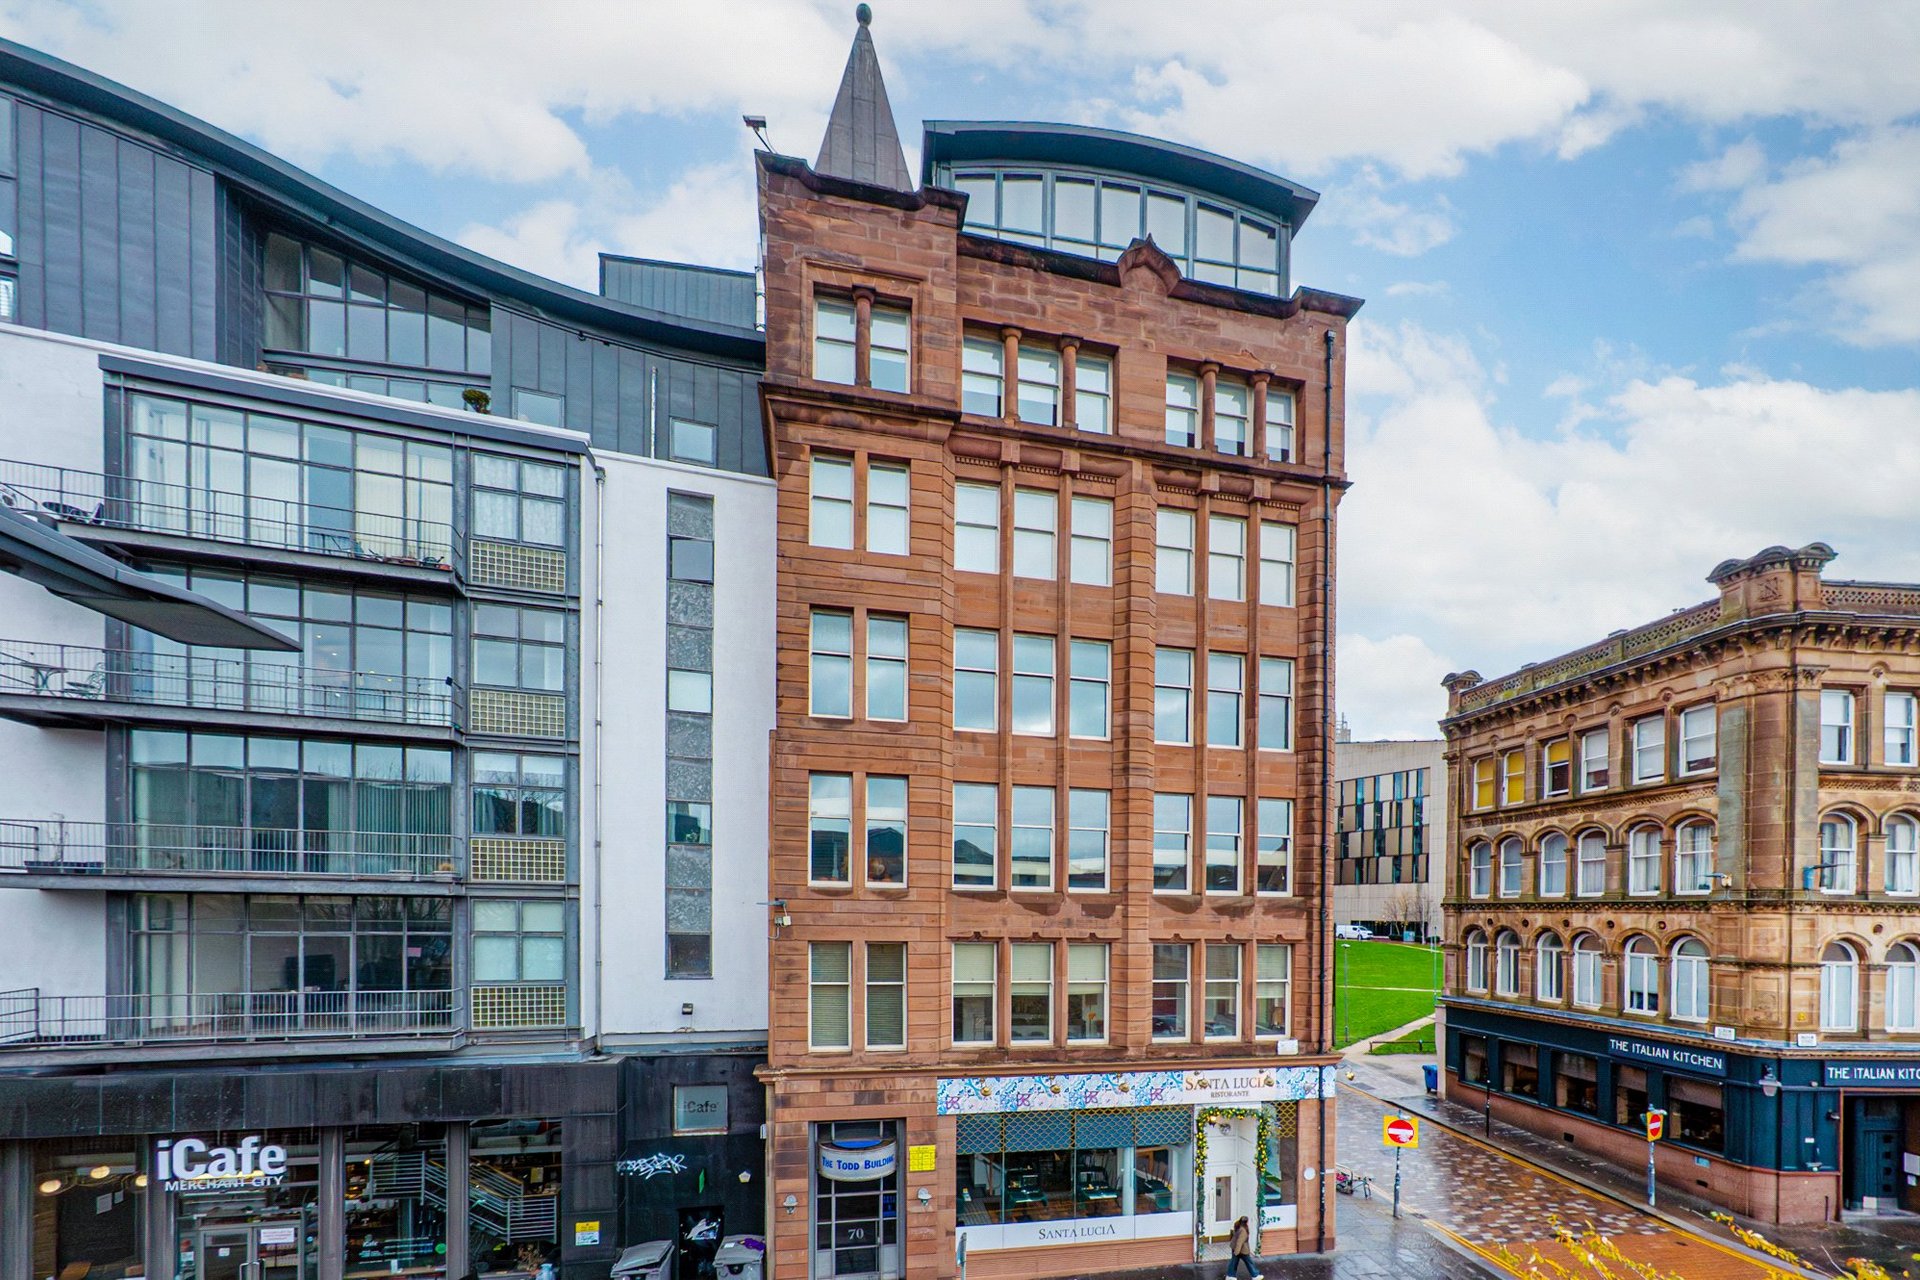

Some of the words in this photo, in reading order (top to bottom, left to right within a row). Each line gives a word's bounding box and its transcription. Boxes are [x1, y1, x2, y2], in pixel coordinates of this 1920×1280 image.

[1609, 1039, 1629, 1052] THE
[1632, 1043, 1669, 1059] ITALIAN
[1673, 1050, 1722, 1069] KITCHEN
[1827, 1066, 1850, 1079] THE
[1853, 1067, 1895, 1079] ITALIAN
[1233, 1075, 1273, 1089] LUCI
[1210, 1090, 1249, 1098] RISTORANTE
[683, 1100, 717, 1113] iCafe
[157, 1135, 287, 1180] iCafe
[822, 1156, 833, 1169] THE
[837, 1160, 860, 1171] TODD
[864, 1154, 894, 1170] BUILDIN
[165, 1177, 245, 1191] MERCHANT
[251, 1175, 284, 1187] CITY
[847, 1228, 865, 1240] 70
[1039, 1228, 1077, 1240] SANTA
[1080, 1224, 1115, 1237] LUCIA
